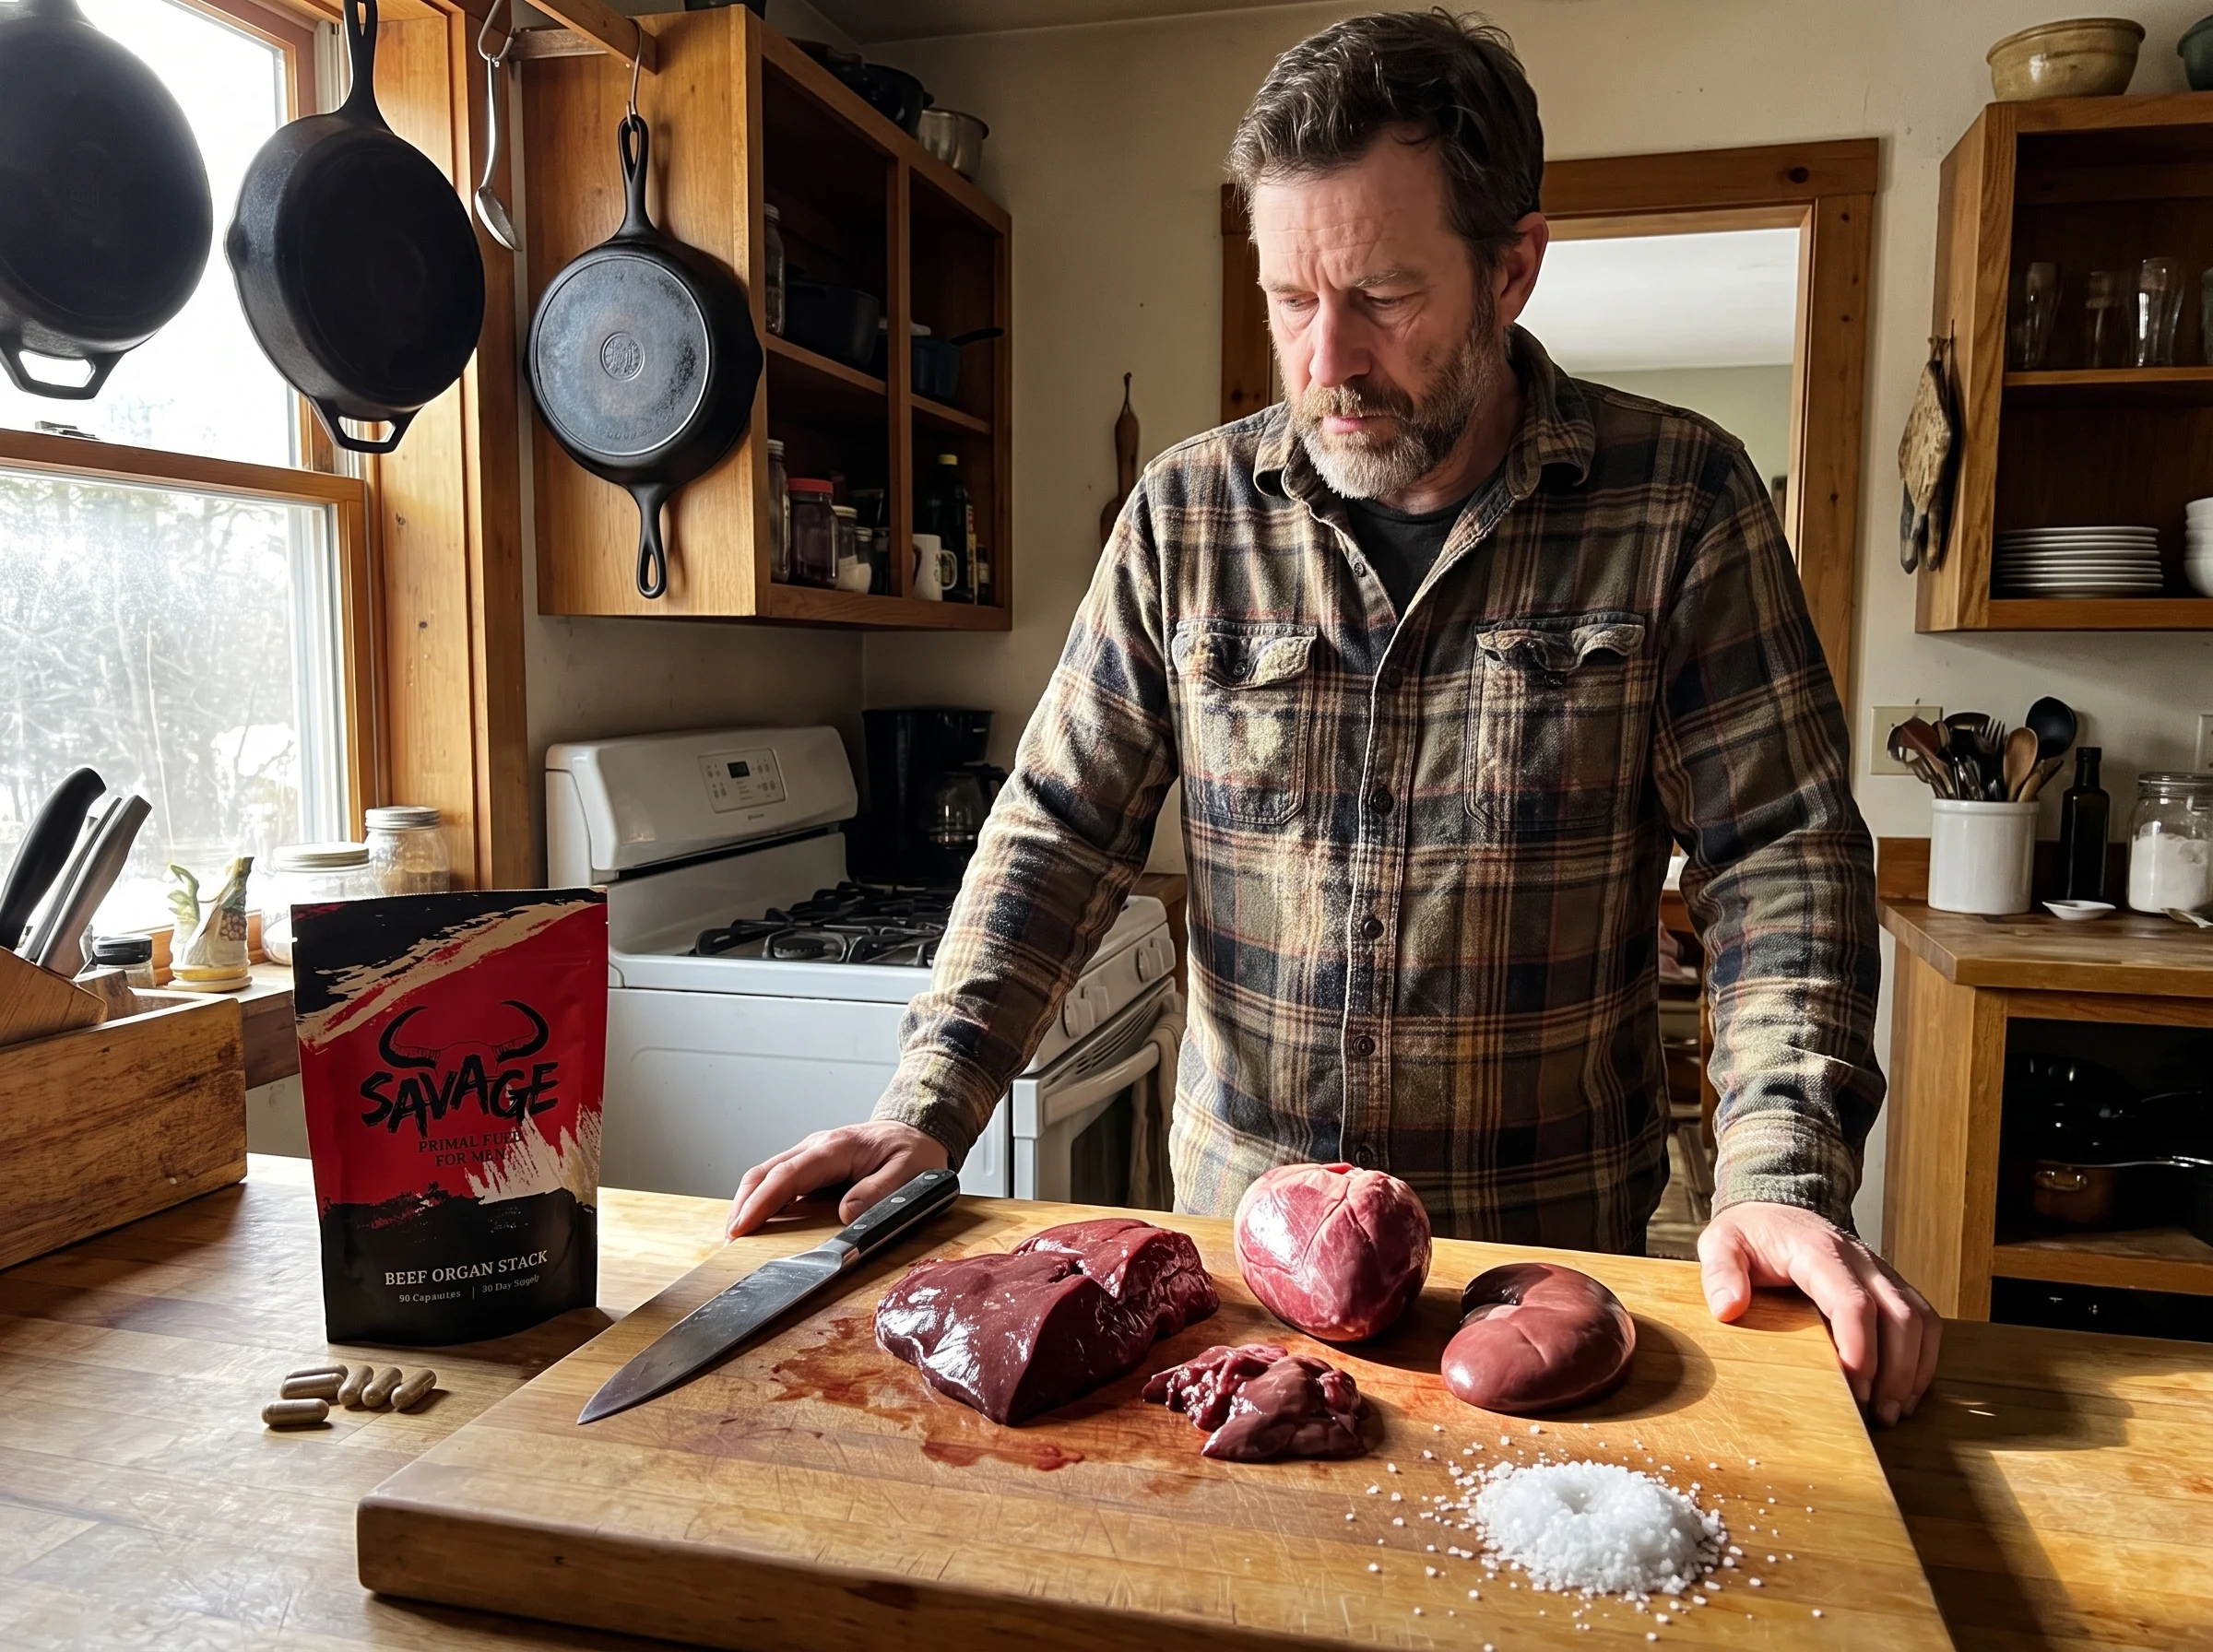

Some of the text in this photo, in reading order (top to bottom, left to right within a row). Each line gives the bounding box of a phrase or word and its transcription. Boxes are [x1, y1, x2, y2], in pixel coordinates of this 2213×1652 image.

[360, 1054, 560, 1139] SAVAGE
[418, 1136, 479, 1153] PRIMAL
[435, 1148, 506, 1167] FOR MEN
[385, 1249, 548, 1286] BEEF ORGAN STACK
[398, 1294, 410, 1303] 90
[481, 1284, 493, 1292] 30
[495, 1281, 513, 1291] Day
